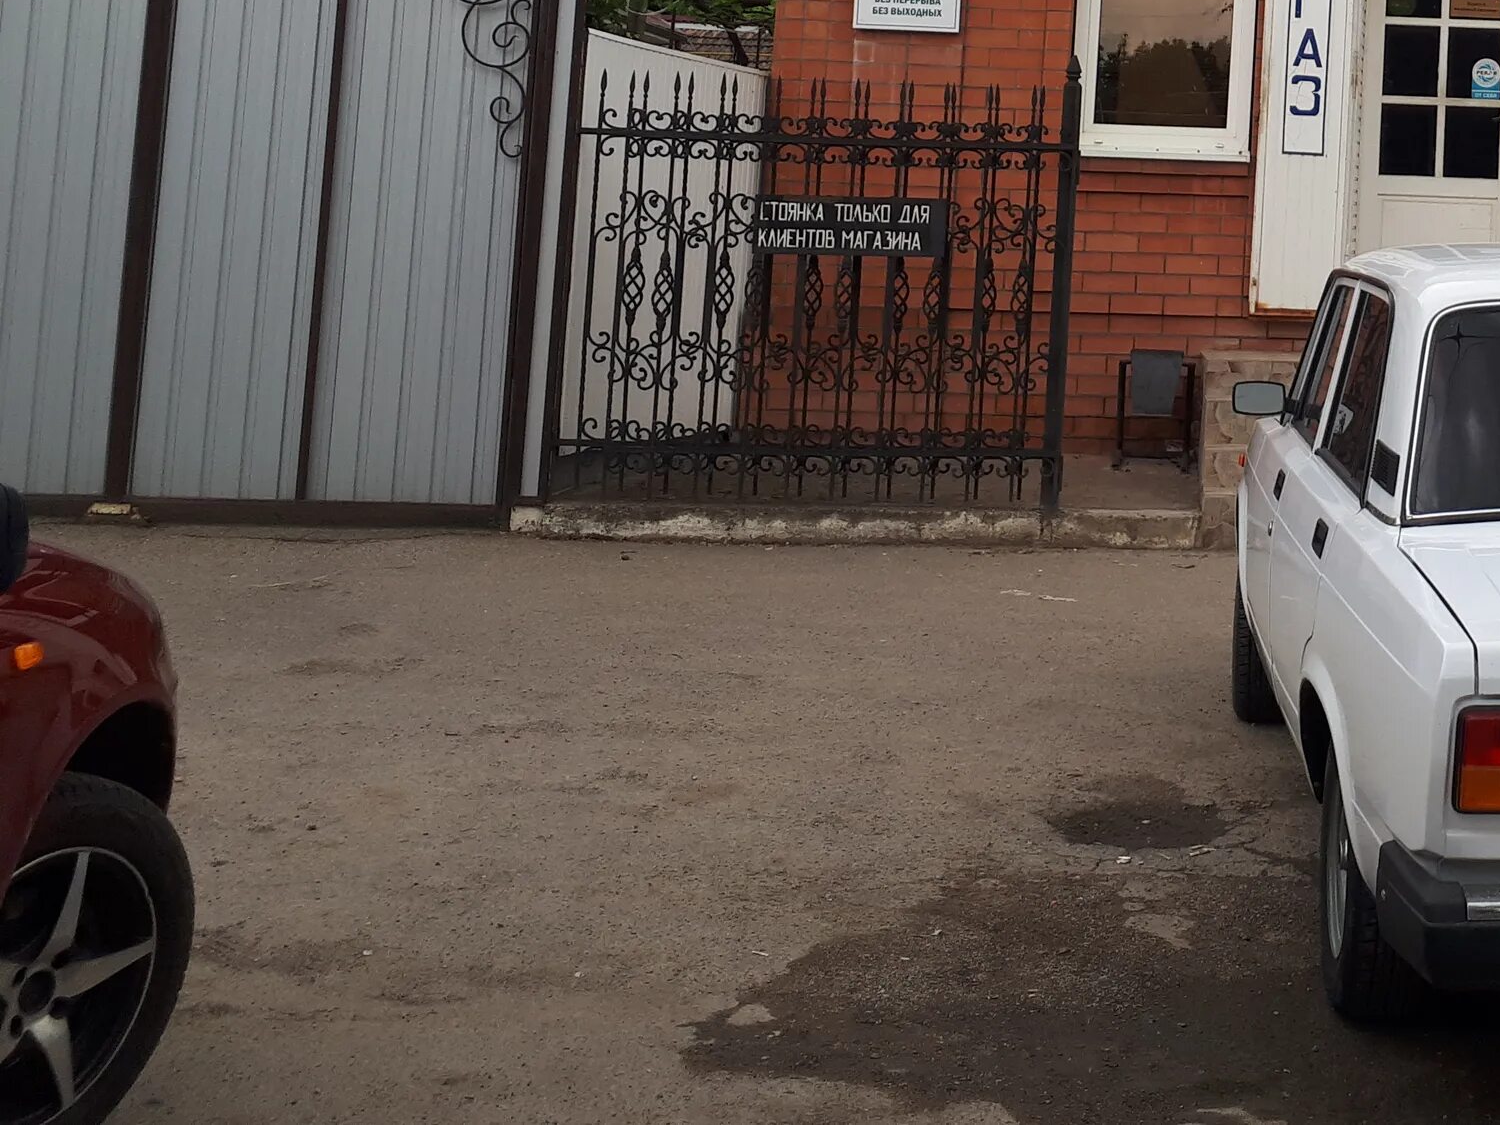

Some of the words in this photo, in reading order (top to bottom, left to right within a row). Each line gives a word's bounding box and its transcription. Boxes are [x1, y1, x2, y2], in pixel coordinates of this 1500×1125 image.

[872, 6, 889, 16] БЕЗ
[890, 7, 943, 18] ВЫХОДНЫХ
[760, 201, 824, 222] СТОЯНКА
[834, 203, 891, 223] ТОЛЬКО
[897, 205, 930, 224] ДЛЯ
[757, 228, 835, 249] КЛИЕНТОВ
[841, 230, 922, 251] МАГАЗИНА
